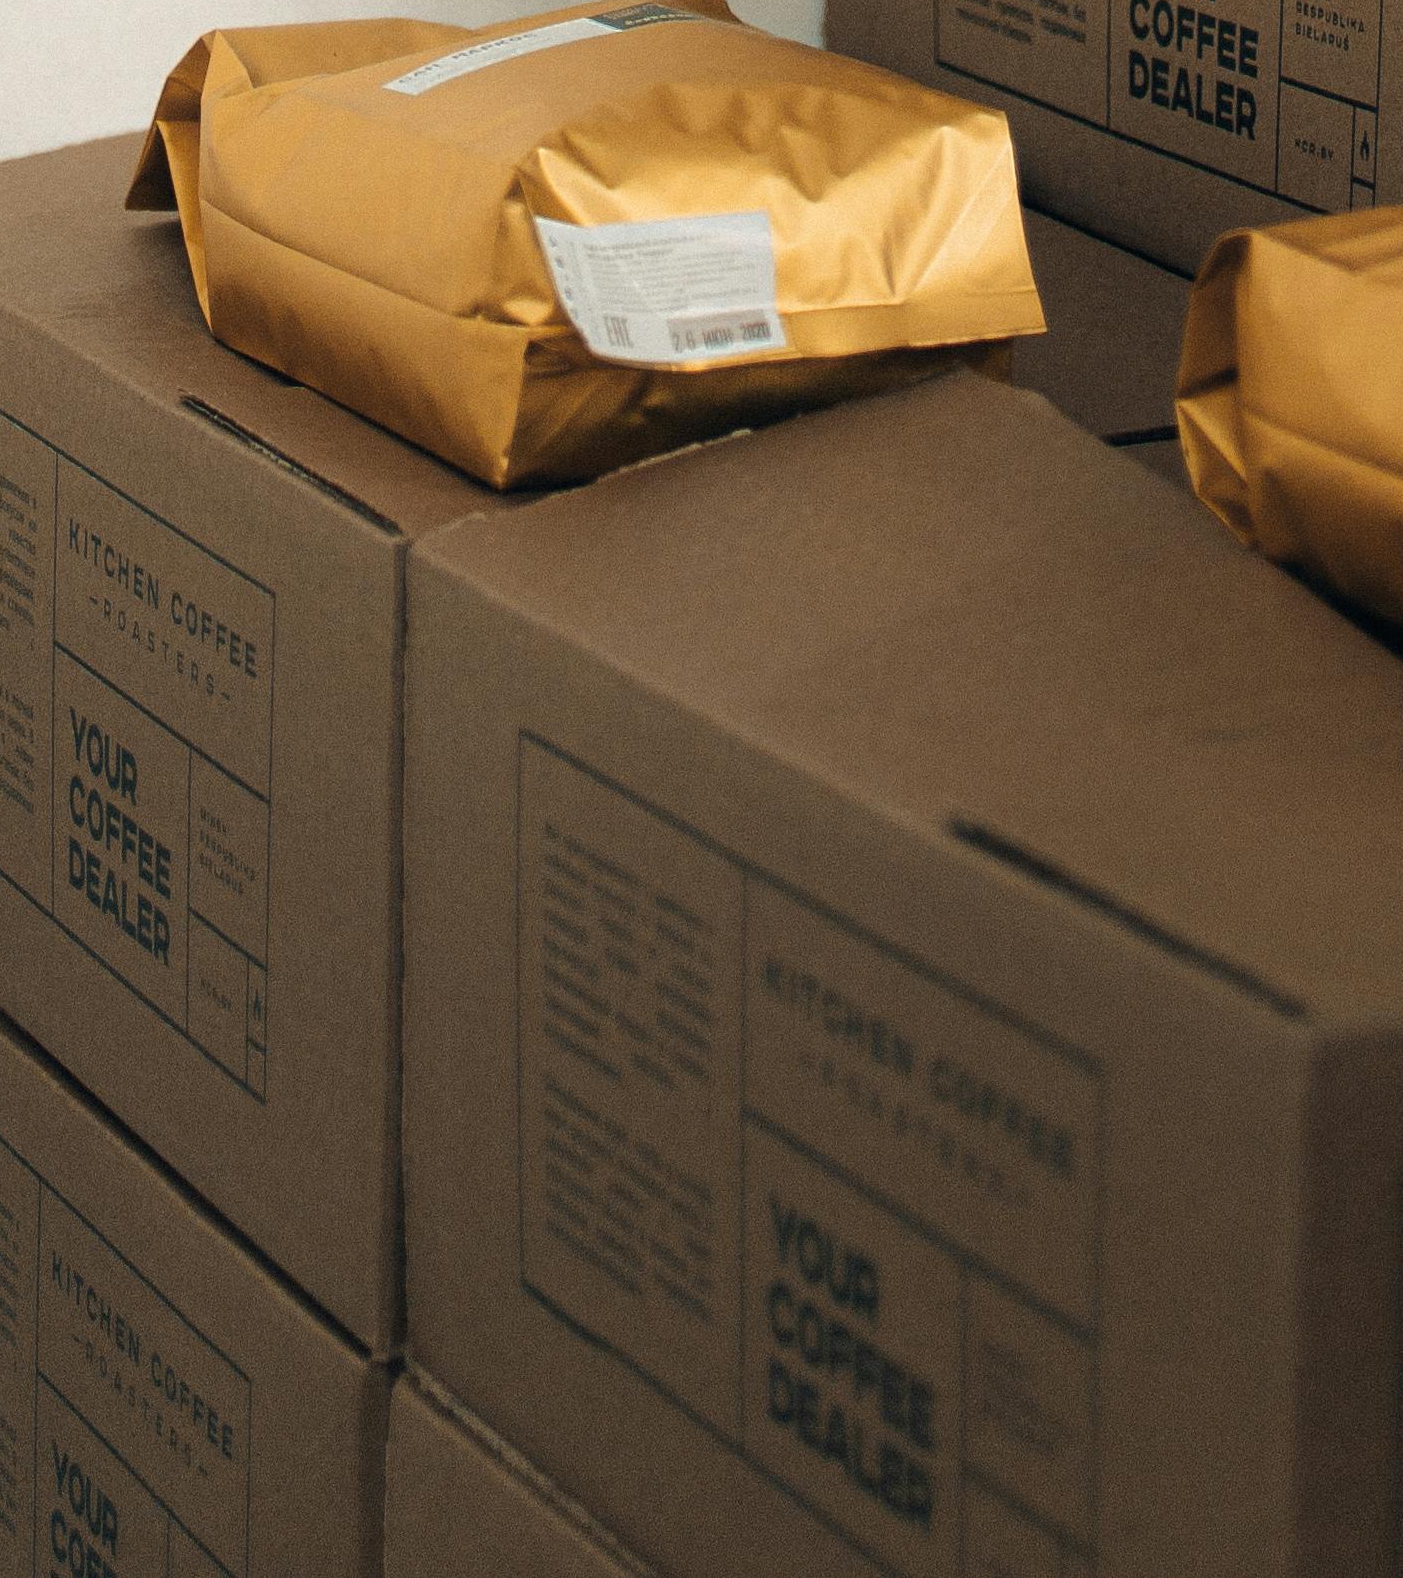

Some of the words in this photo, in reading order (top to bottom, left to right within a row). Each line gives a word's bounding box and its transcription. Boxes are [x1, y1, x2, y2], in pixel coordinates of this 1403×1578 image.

[1128, 48, 1257, 141] DEALER
[68, 517, 159, 610] KITCHEN
[170, 591, 256, 678] COFFEE
[69, 705, 138, 806] YOUR
[68, 774, 171, 900] COFFEE
[68, 835, 170, 967] DEALER
